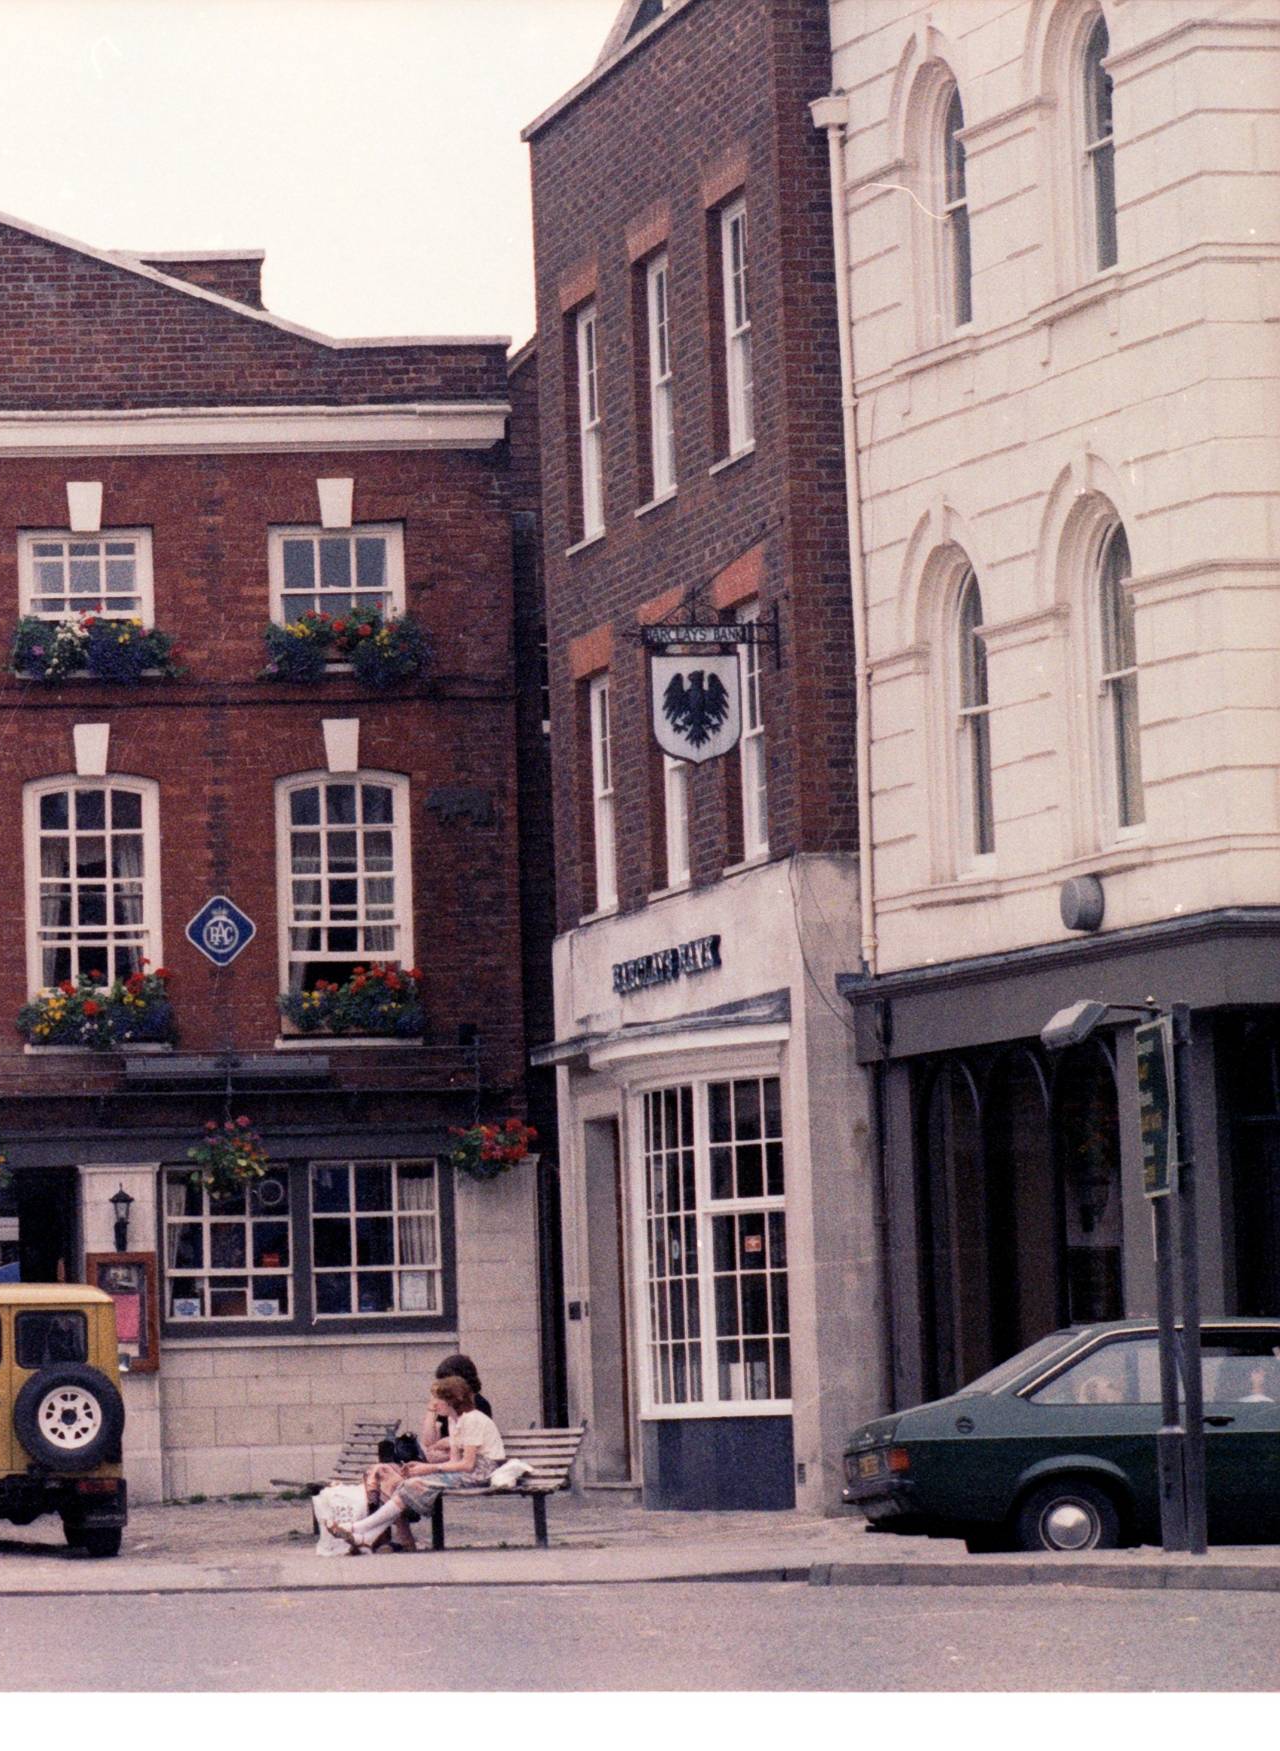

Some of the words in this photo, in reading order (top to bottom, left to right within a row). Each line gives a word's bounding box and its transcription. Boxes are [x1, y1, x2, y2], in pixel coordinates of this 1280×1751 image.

[209, 920, 233, 946] RAC
[612, 948, 680, 996] BARCLAYS
[678, 934, 722, 979] BANK
